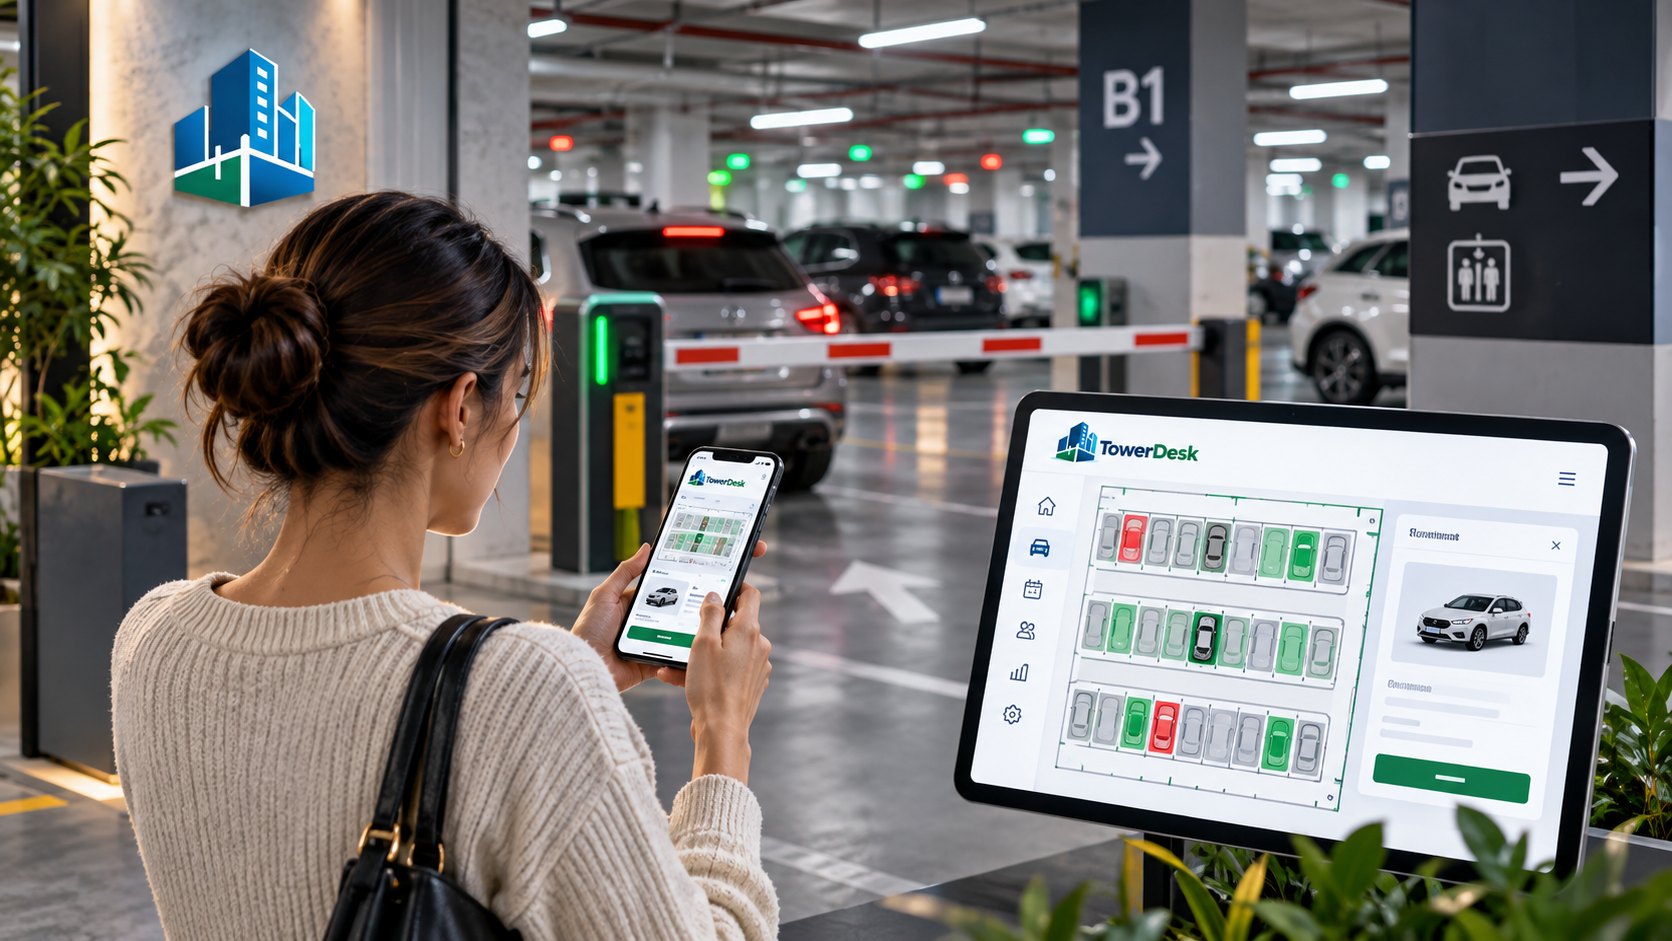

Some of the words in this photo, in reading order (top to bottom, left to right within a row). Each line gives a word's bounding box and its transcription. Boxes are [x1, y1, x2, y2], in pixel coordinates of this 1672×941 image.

[1103, 66, 1164, 129] B1
[1100, 440, 1199, 461] TowerDesk
[706, 476, 745, 487] TowerDesk
